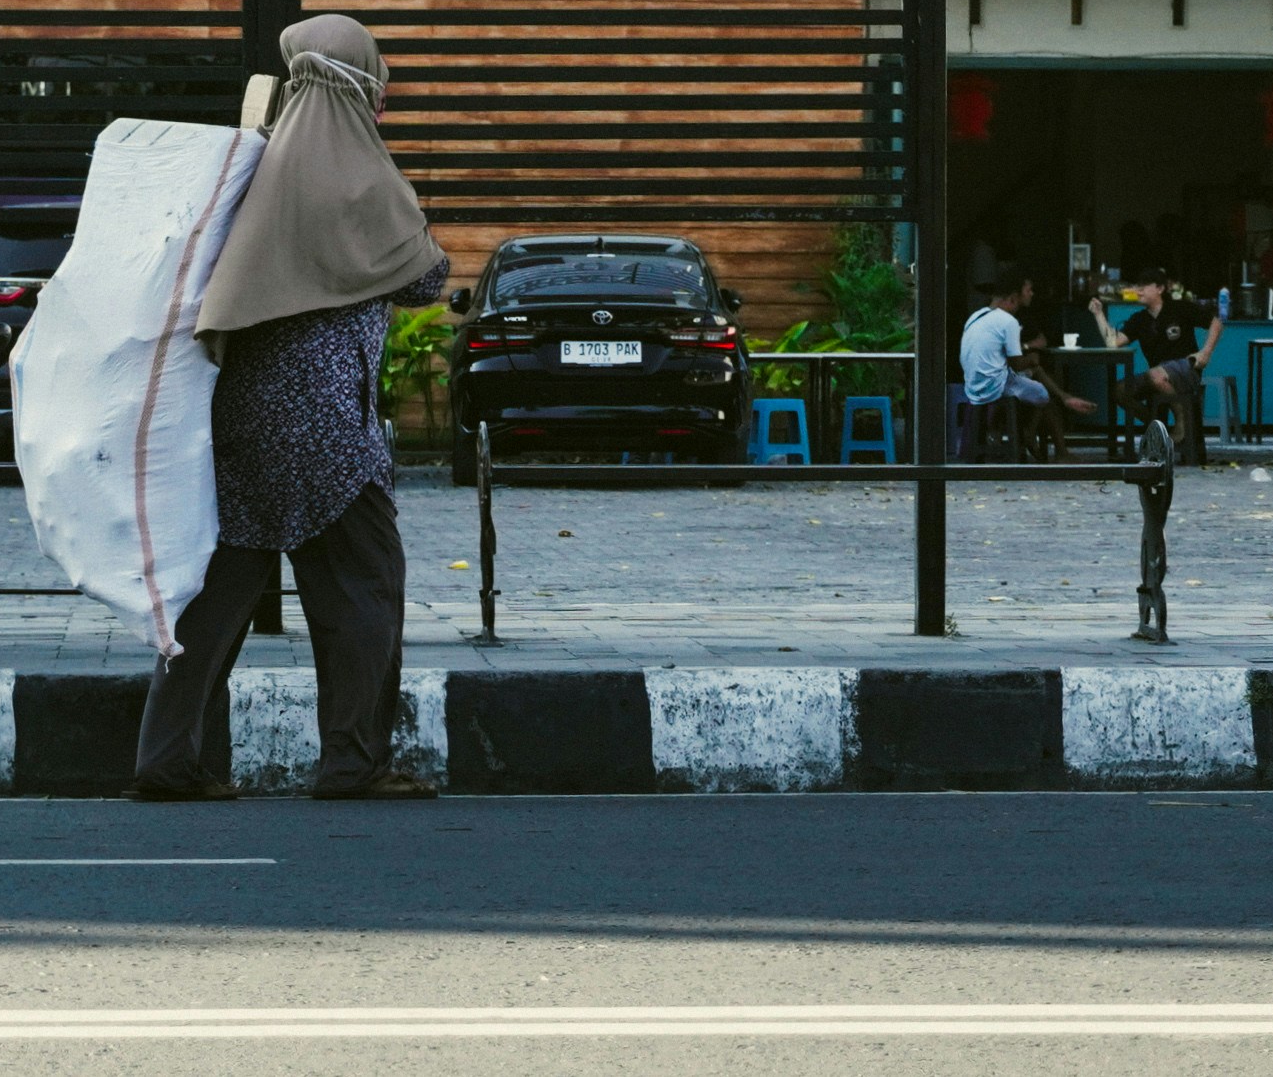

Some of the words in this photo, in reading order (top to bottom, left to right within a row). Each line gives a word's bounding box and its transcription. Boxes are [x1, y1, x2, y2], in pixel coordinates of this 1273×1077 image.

[563, 343, 571, 356] B
[579, 343, 609, 356] 1703
[616, 343, 639, 356] PAK
